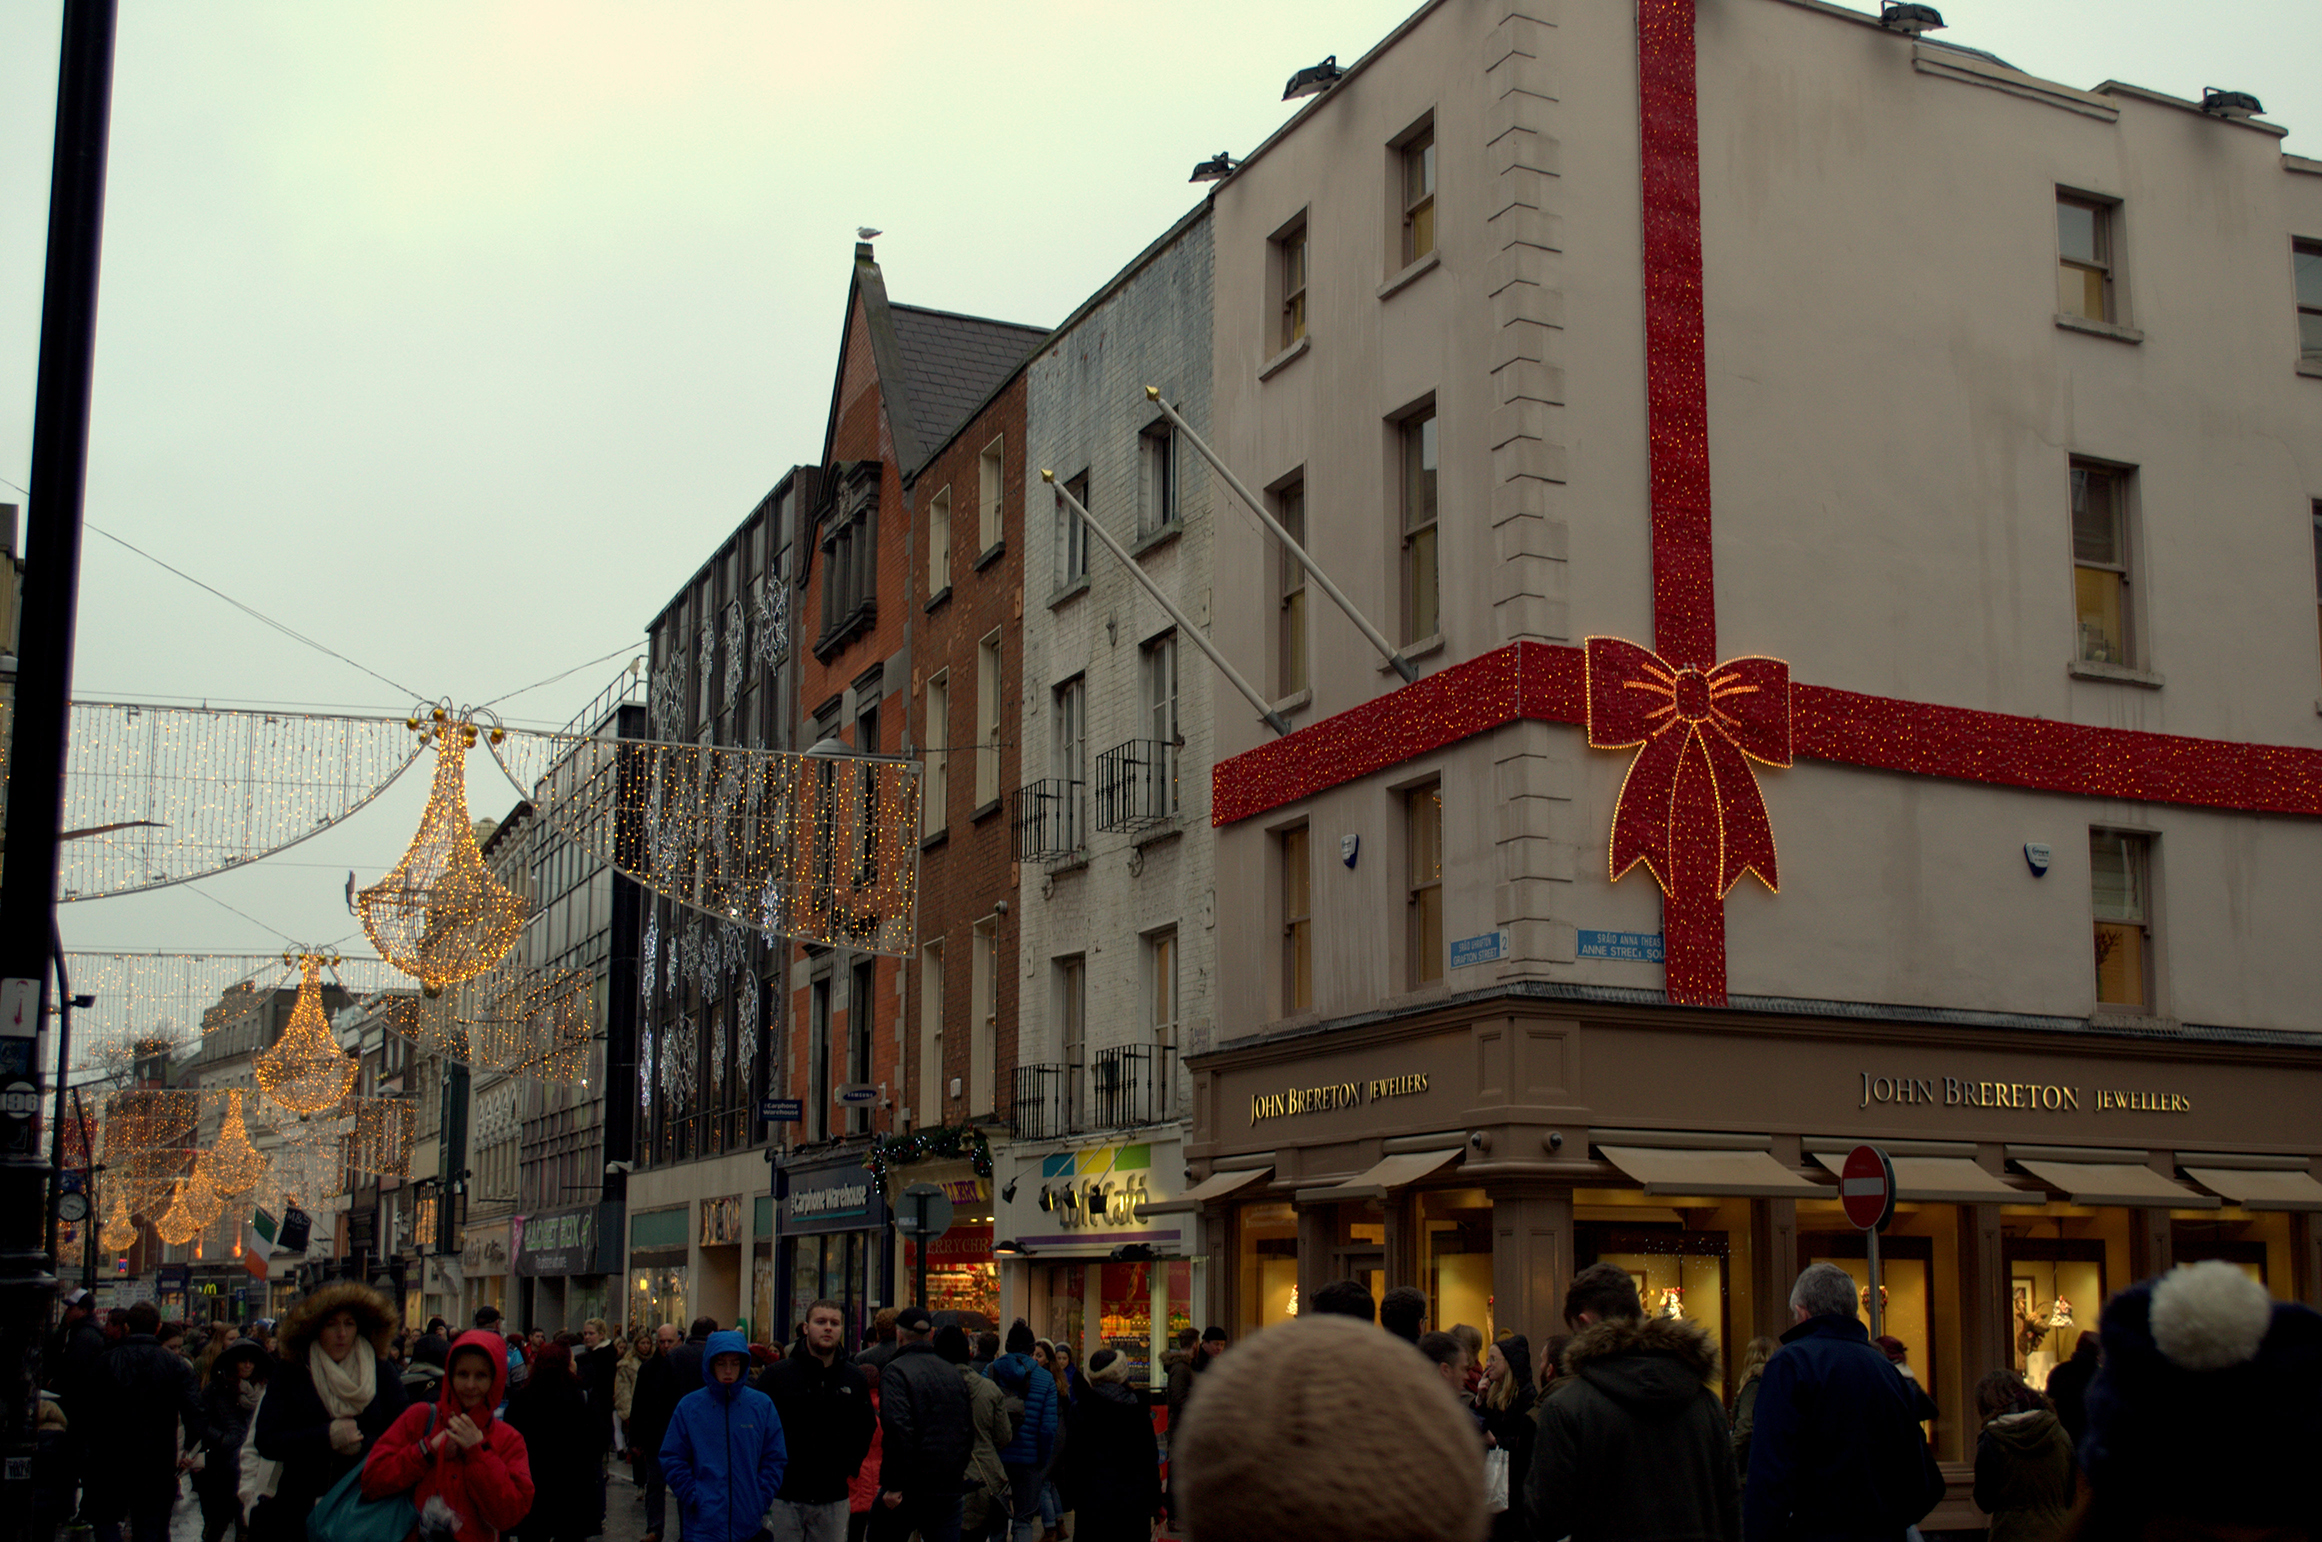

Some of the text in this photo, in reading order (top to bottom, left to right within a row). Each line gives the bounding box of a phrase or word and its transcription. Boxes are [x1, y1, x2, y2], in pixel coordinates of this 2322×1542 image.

[1502, 936, 1509, 951] 2
[1597, 932, 1618, 945] SRÁID
[1620, 935, 1639, 946] ANNA
[1453, 947, 1498, 966] GRAFTON STREET
[1581, 944, 1607, 956] ANNE
[1250, 1073, 1428, 1127] JOHN BRERETON JEWELLERS
[1860, 1072, 2191, 1112] JOHN BRERETON JEWELLERS
[767, 1102, 798, 1110] Carphone
[795, 1187, 826, 1216] Carphone
[825, 1183, 867, 1210] Warehouse
[287, 1210, 310, 1226] M&S
[559, 1214, 581, 1249] BOX
